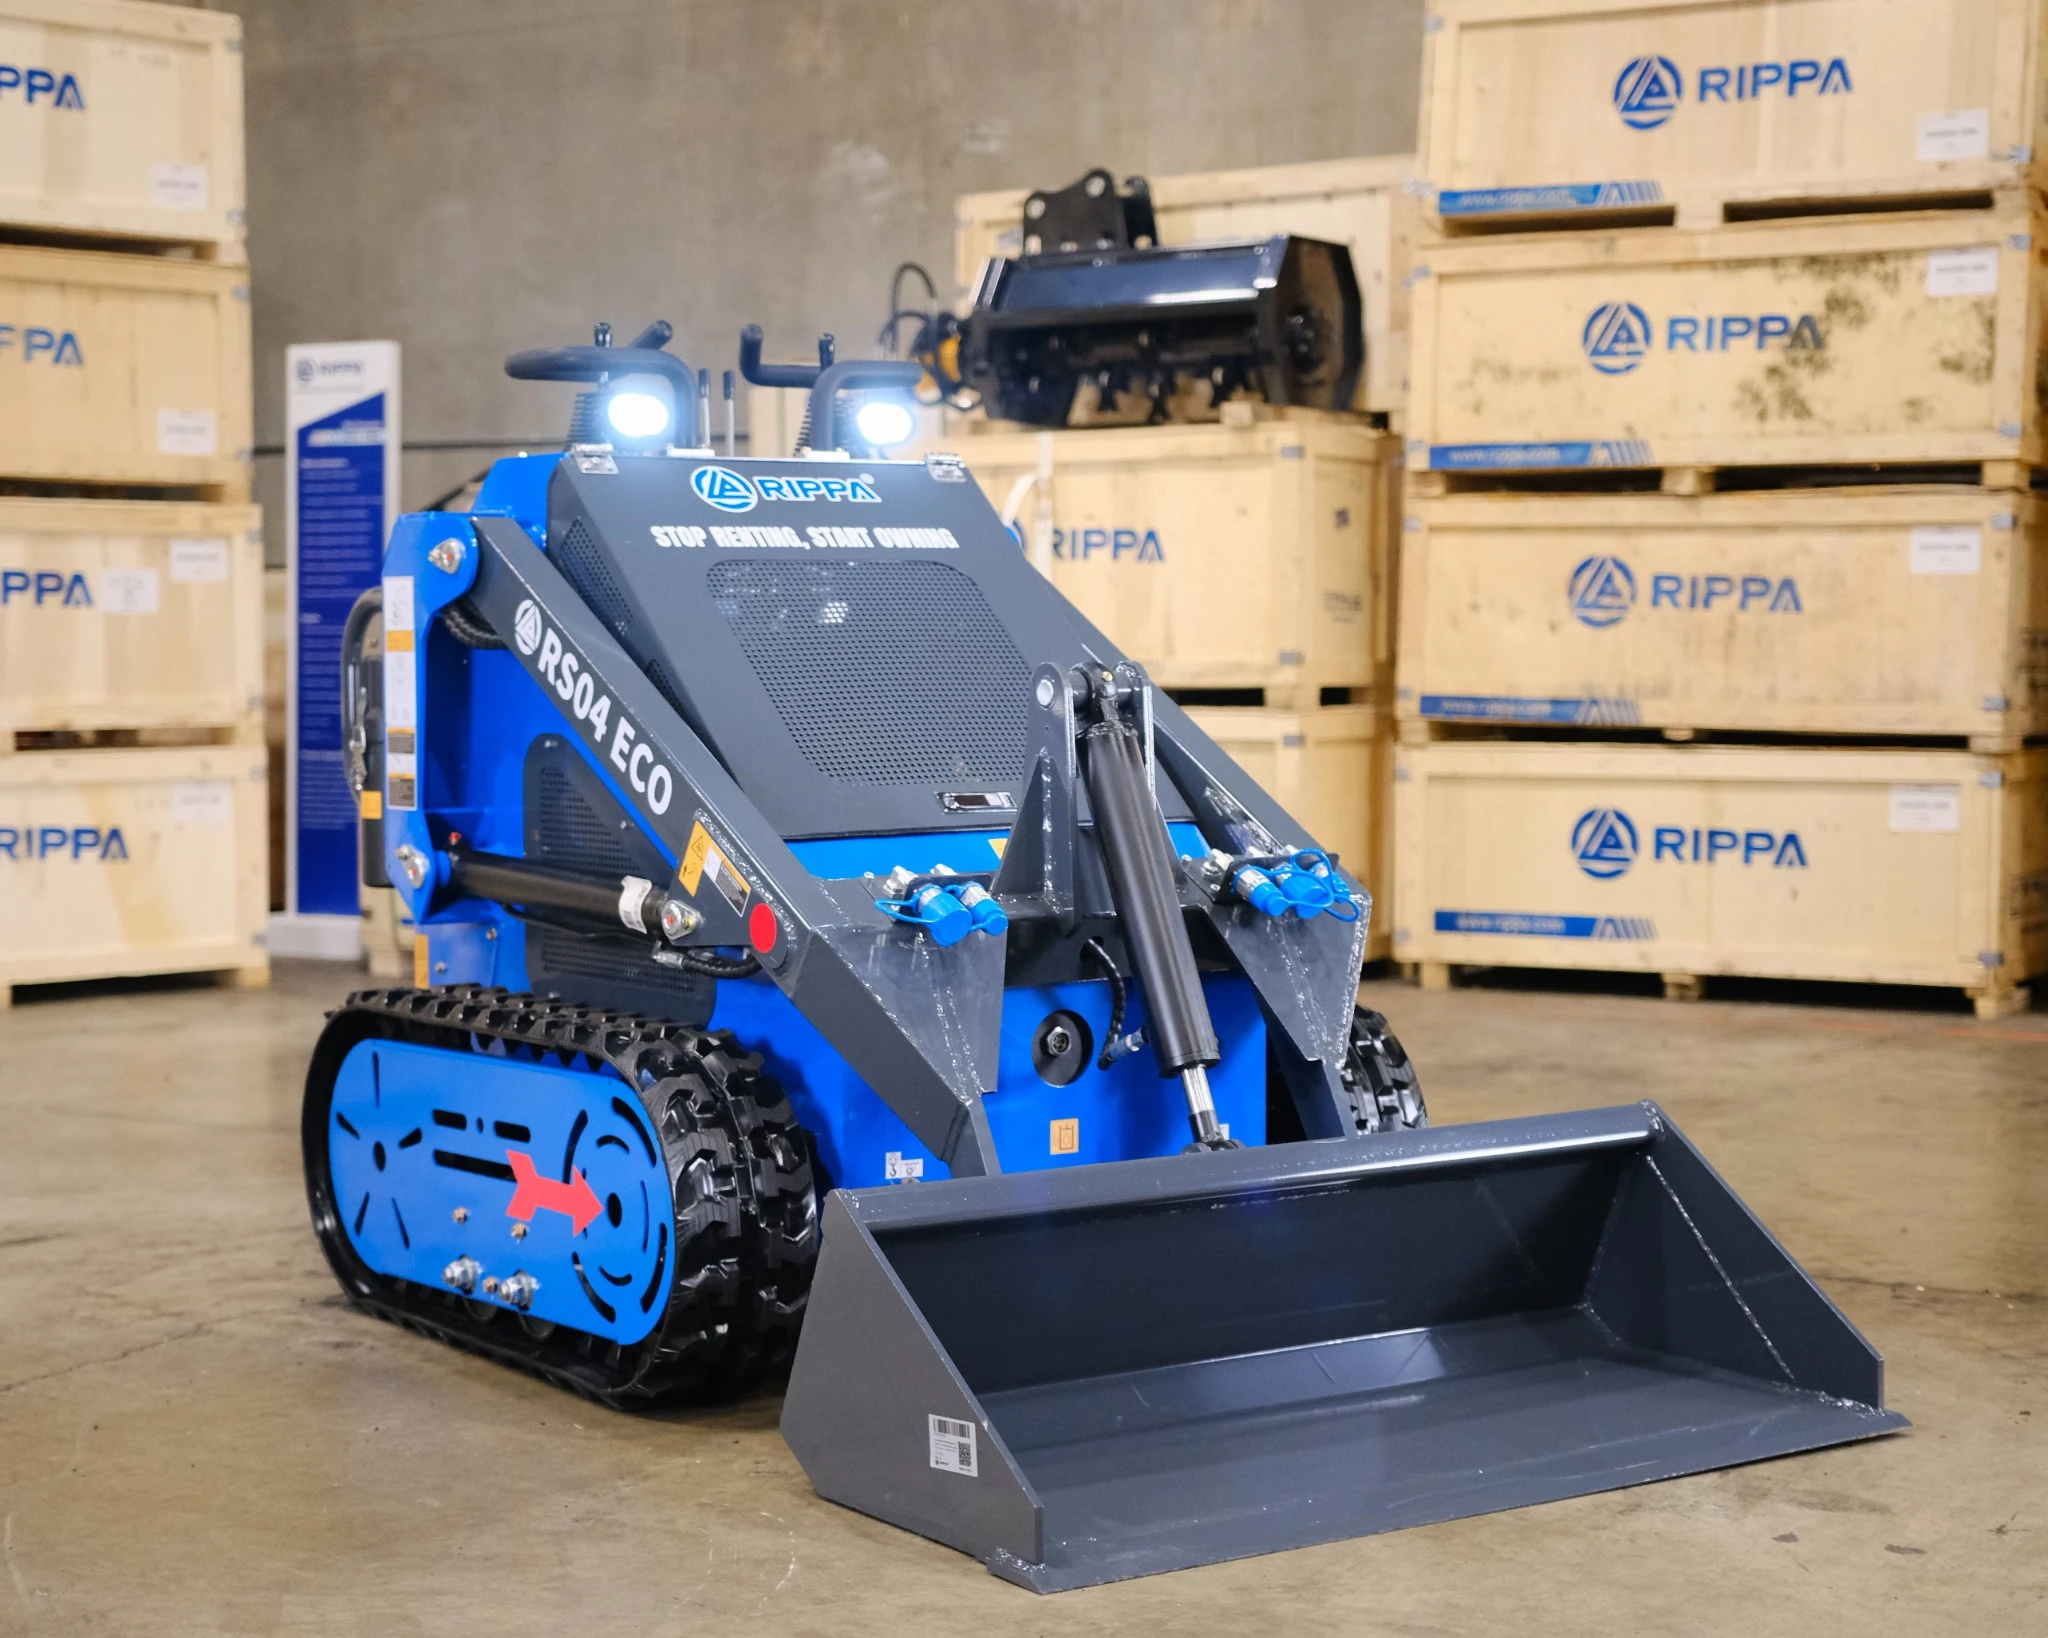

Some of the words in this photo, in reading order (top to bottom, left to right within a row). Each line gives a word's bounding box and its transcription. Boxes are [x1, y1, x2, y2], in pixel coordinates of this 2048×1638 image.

[1698, 57, 1853, 102] RIPPA
[1667, 314, 1824, 351] RIPPA
[757, 478, 876, 499] RIPPA
[649, 525, 707, 548] STOP
[707, 525, 811, 550] RENTING,
[805, 526, 875, 548] START
[872, 526, 960, 549] OWNING
[1, 570, 92, 605] PPA
[1651, 573, 1803, 613] RIPPA
[537, 627, 612, 743] RS04
[609, 716, 673, 816] ECO
[1653, 826, 1807, 867] RIPPA
